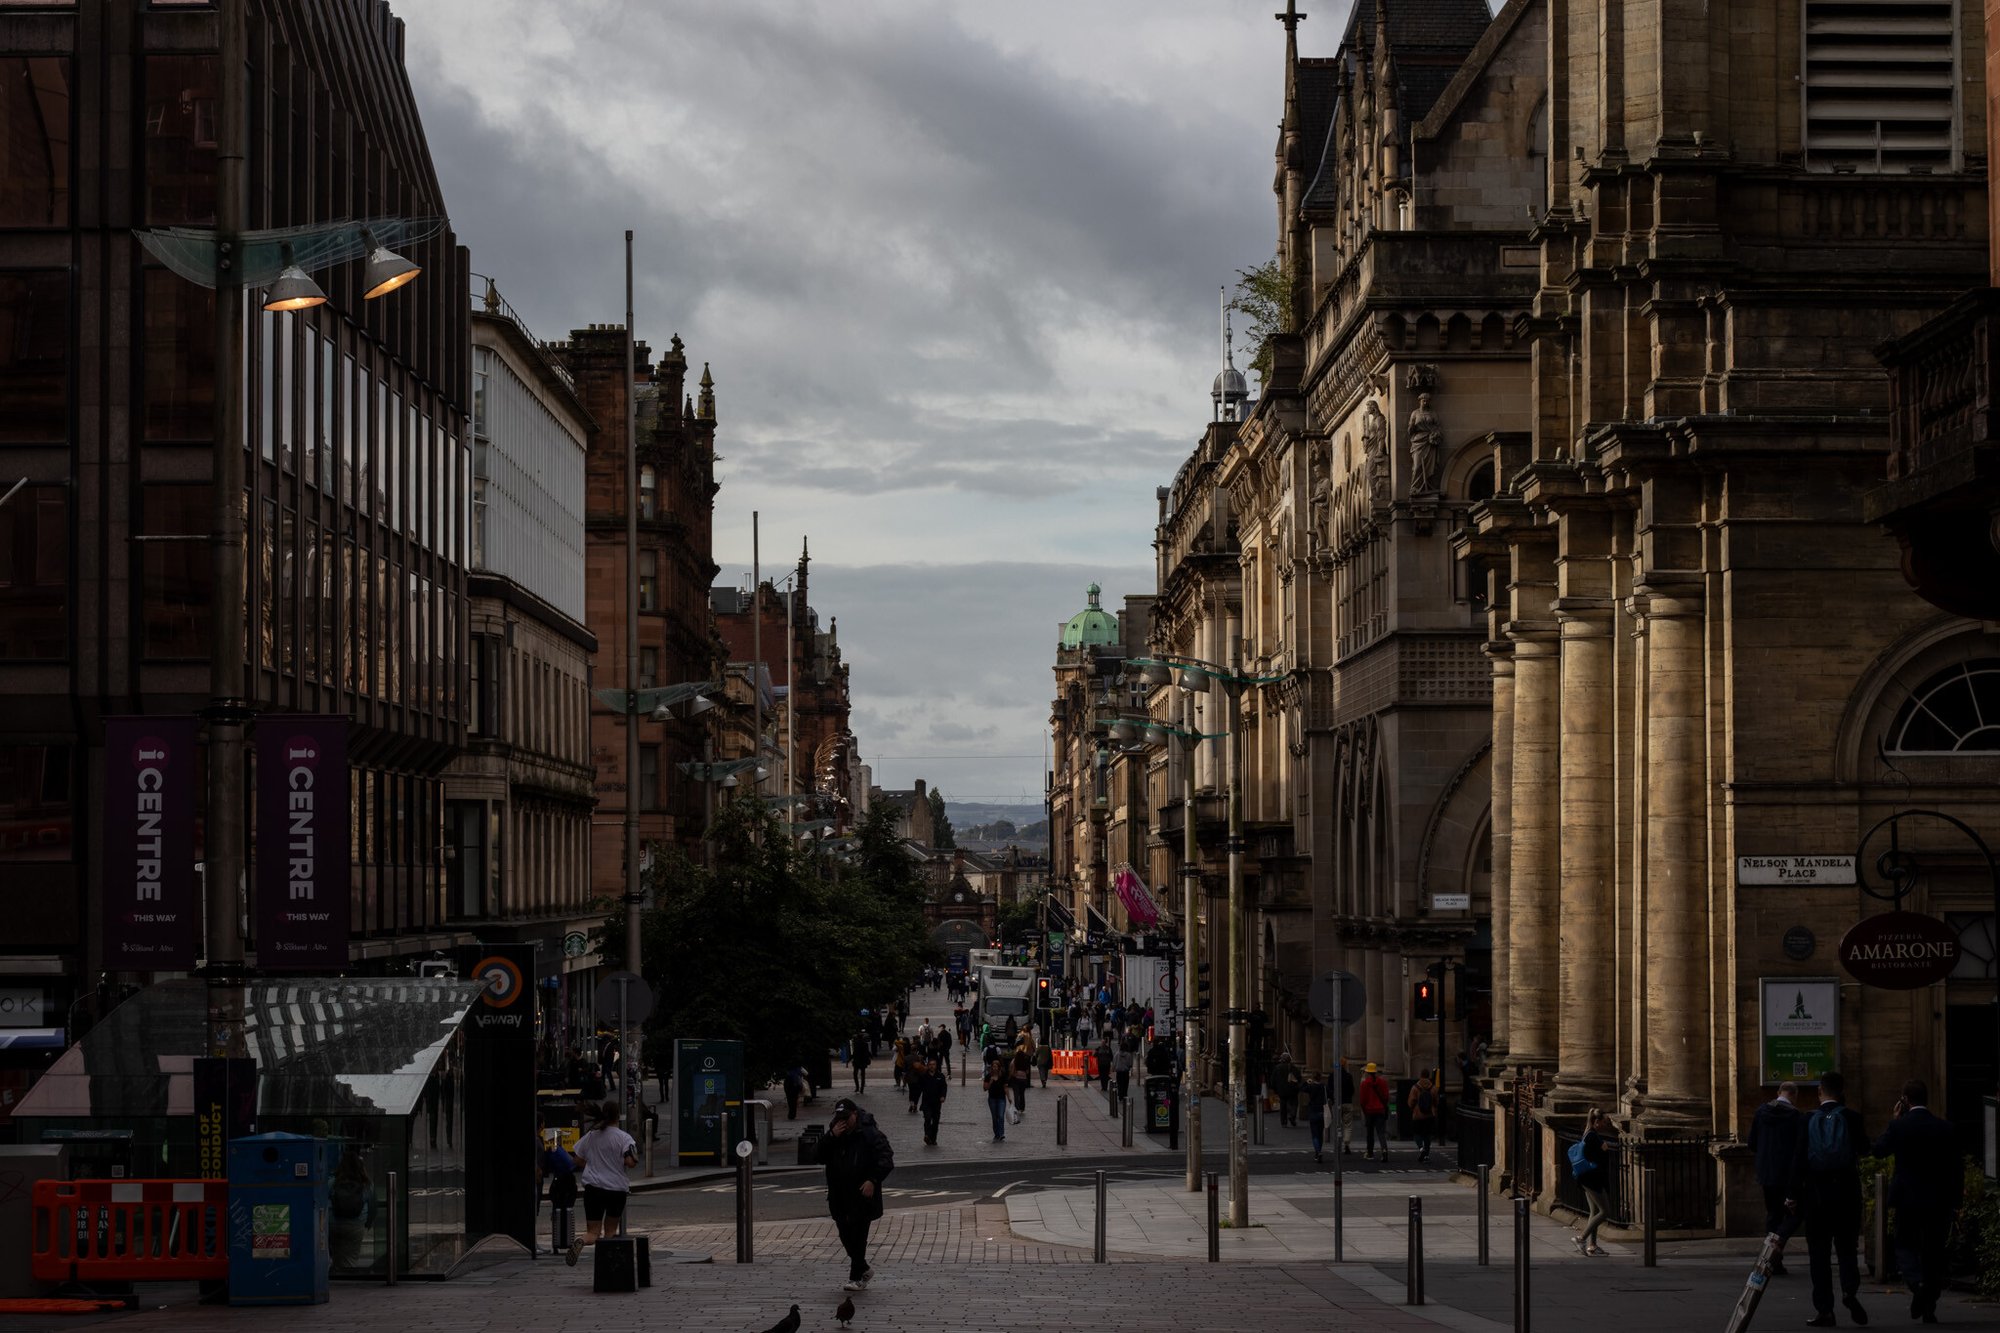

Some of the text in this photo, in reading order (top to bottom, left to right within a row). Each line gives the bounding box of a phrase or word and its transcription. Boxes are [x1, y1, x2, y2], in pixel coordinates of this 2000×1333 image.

[1744, 858, 1852, 868] NELSON MANDELA
[1778, 868, 1816, 878] PLACE
[133, 913, 176, 922] THIS WAY
[286, 912, 330, 921] THIS WAY
[1878, 932, 1923, 941] PIZZERIA
[1849, 941, 1954, 960] AMARONE
[1871, 960, 1932, 969] RISTORANTE
[200, 1114, 210, 1135] OF
[211, 1102, 222, 1178] CONDUCT
